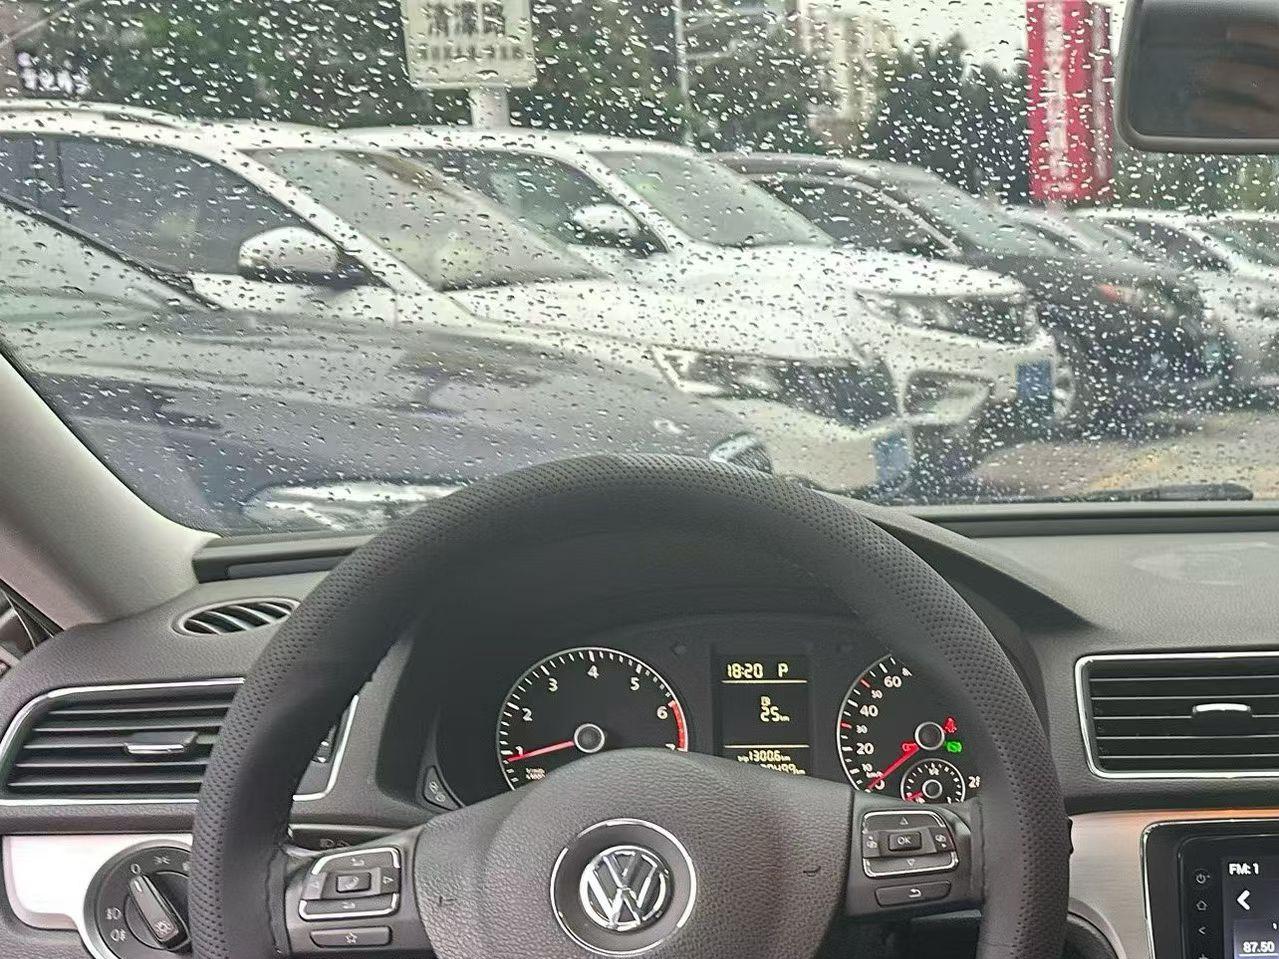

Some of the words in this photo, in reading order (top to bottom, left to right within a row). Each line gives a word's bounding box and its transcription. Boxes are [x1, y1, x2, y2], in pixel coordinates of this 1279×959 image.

[587, 665, 600, 679] 4
[727, 662, 763, 679] 18:20
[777, 662, 789, 678] P
[548, 677, 559, 692] 3
[630, 676, 641, 691] 5
[883, 675, 902, 688] 60
[521, 707, 533, 722] 2
[656, 705, 669, 720] 6
[859, 704, 879, 717] 40
[856, 742, 875, 755] 20
[897, 836, 911, 845] OK
[1253, 863, 1260, 875] 1
[1243, 940, 1275, 953] 87.50
